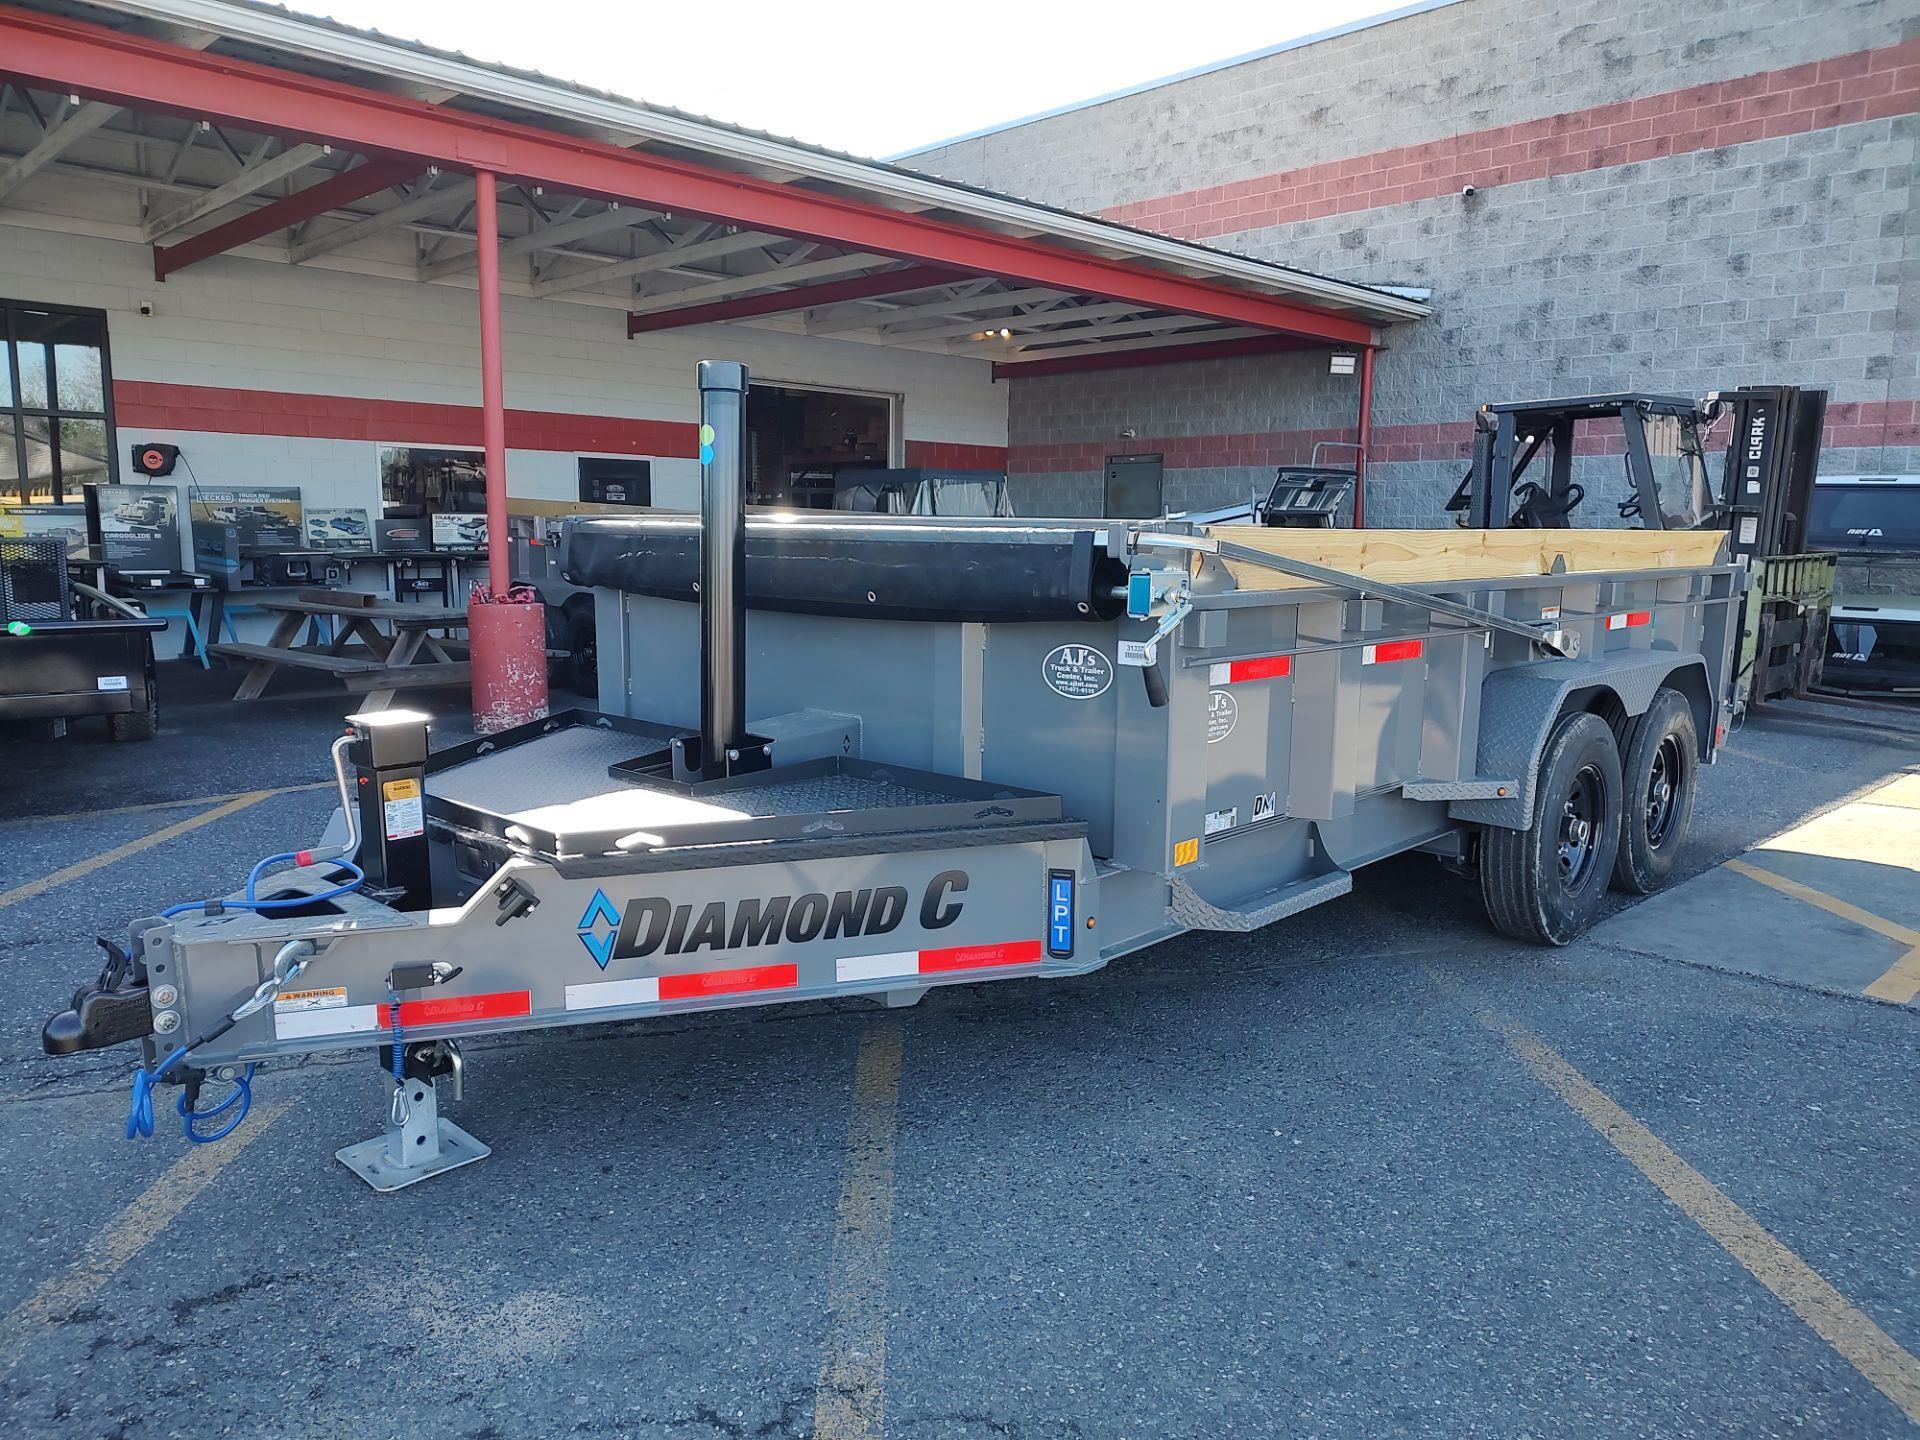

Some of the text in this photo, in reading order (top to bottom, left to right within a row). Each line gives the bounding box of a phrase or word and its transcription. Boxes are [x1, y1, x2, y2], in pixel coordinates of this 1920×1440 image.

[1748, 417, 1766, 460] CLARK
[1060, 648, 1096, 666] AJ's
[1050, 664, 1071, 672] Truck
[1081, 666, 1105, 675] Trailer
[1056, 672, 1098, 682] Center, Inc.
[1253, 794, 1276, 816] DM
[612, 869, 970, 961] DIAMOND C
[1054, 884, 1068, 943] LPT
[294, 990, 335, 999] WARNING
